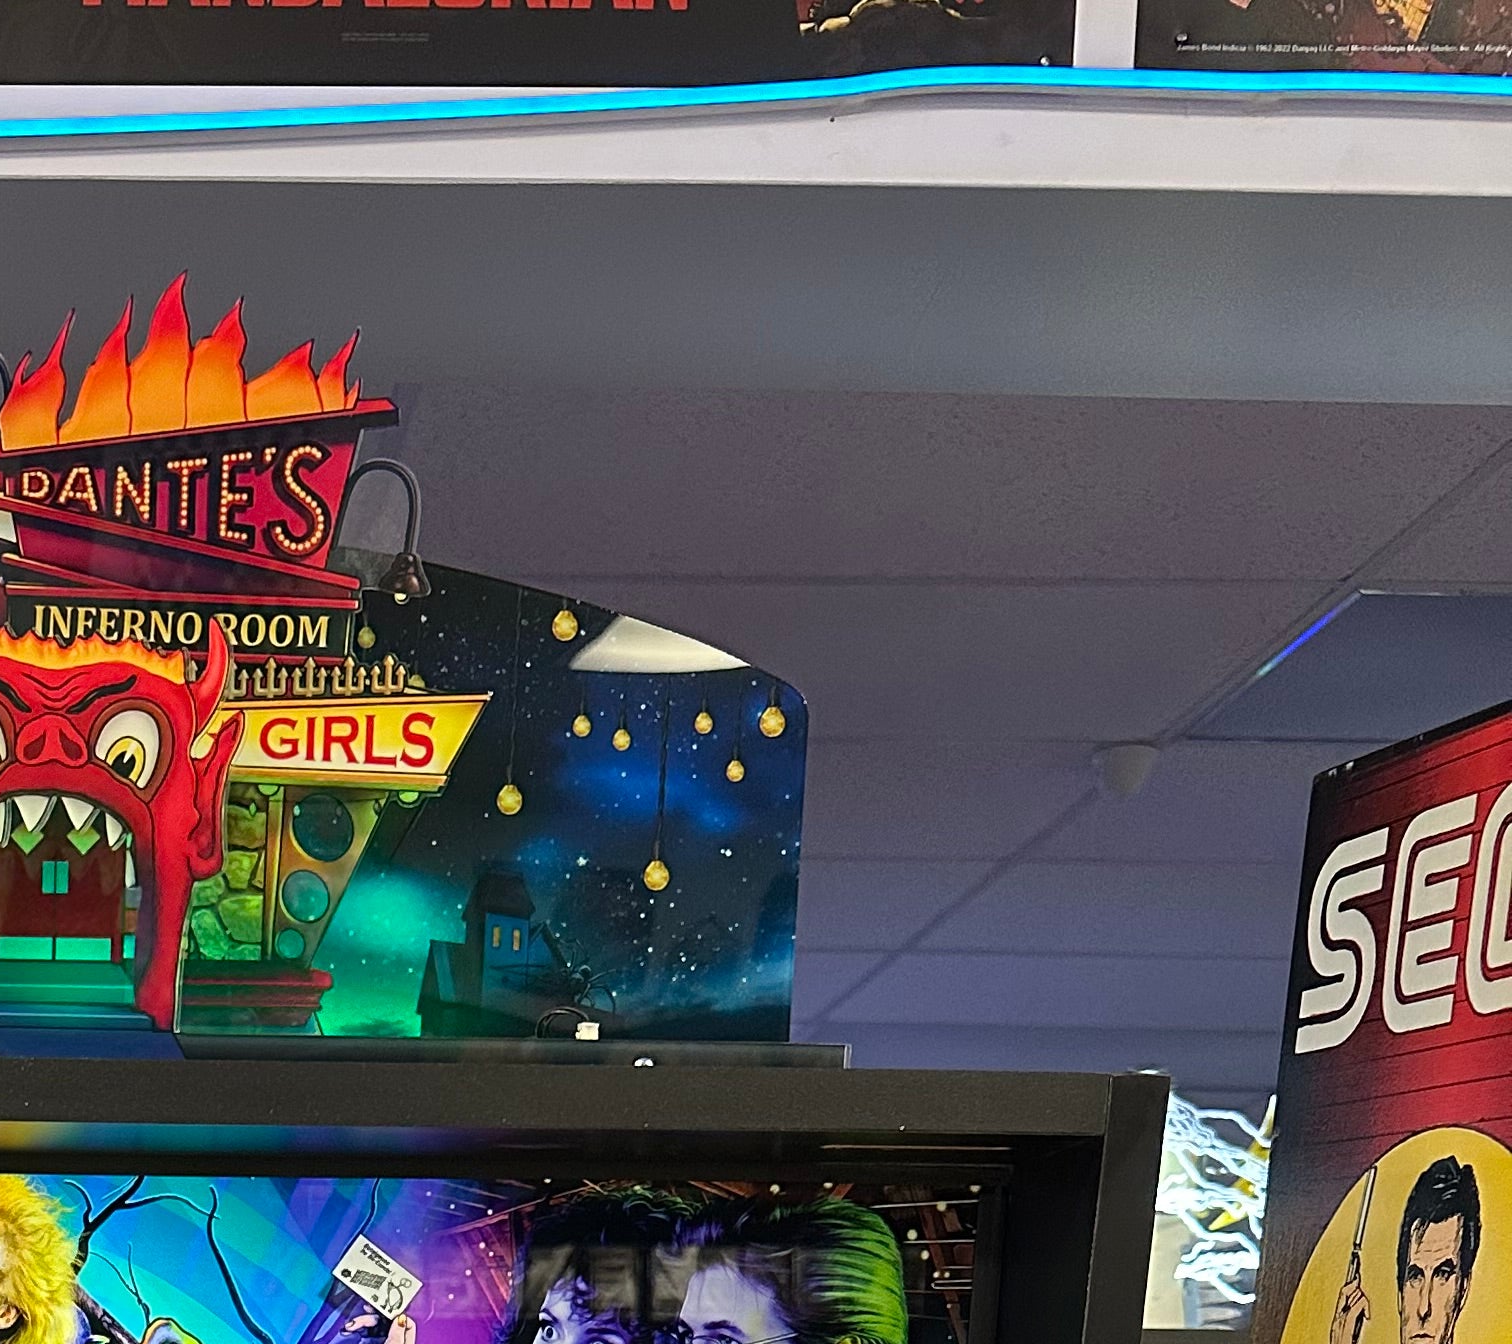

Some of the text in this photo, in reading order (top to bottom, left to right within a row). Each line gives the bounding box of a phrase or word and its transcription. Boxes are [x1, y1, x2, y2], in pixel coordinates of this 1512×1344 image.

[19, 442, 332, 558] DANTE'S
[33, 603, 330, 650] INFERNO ROOM
[258, 710, 436, 770] GIRLS
